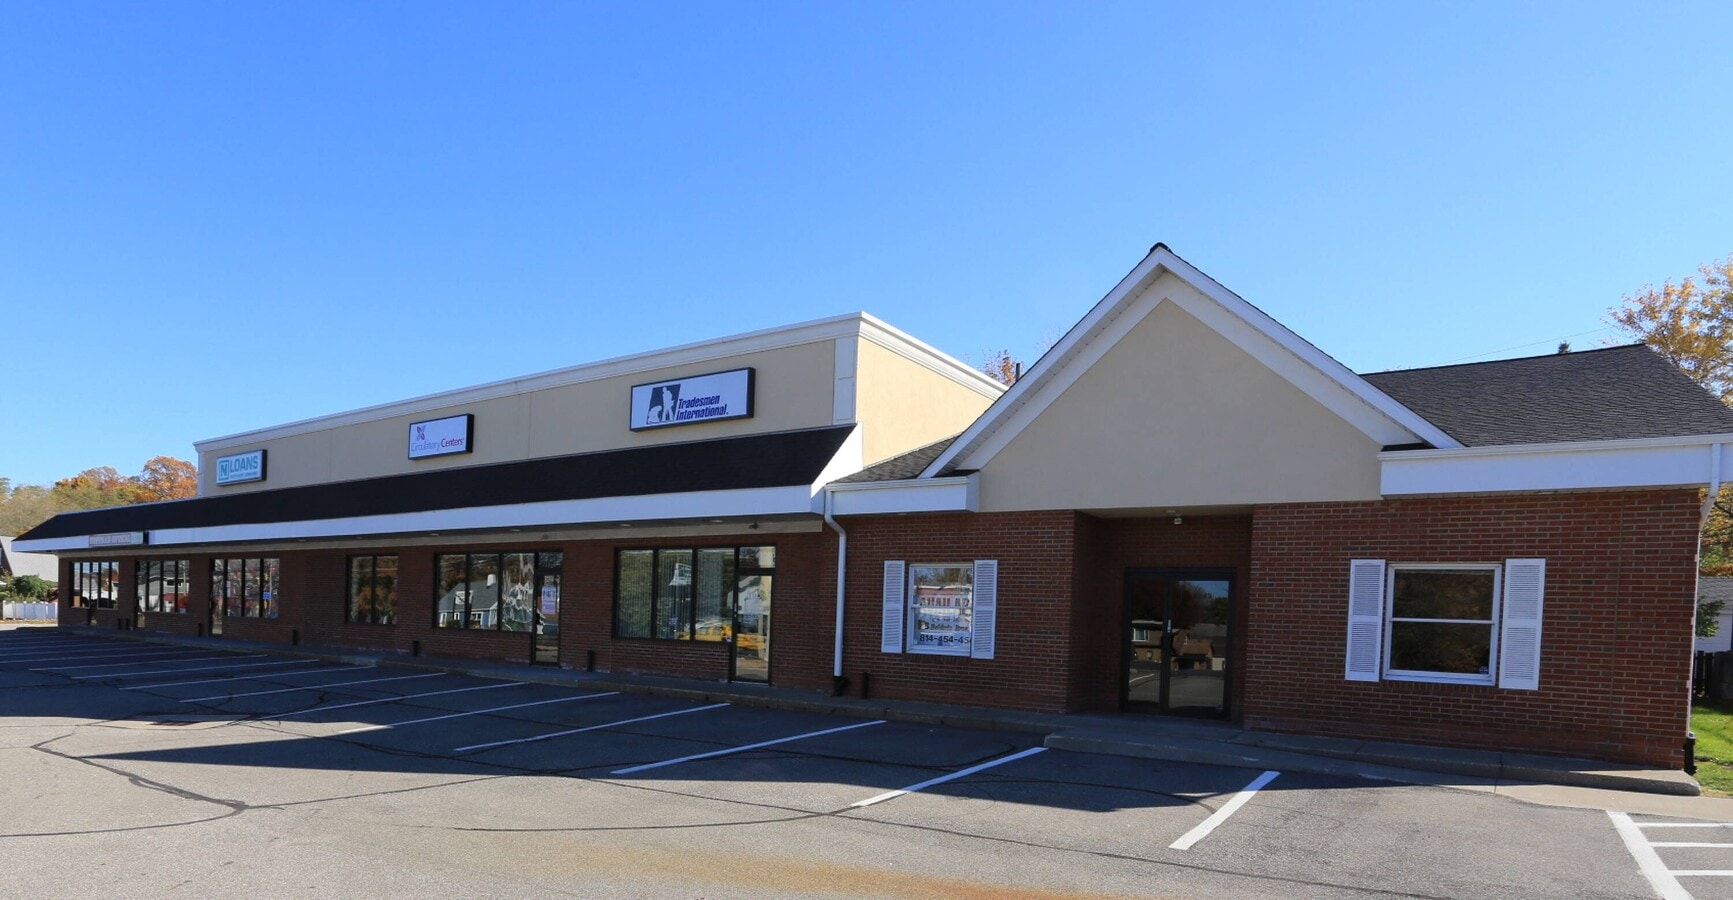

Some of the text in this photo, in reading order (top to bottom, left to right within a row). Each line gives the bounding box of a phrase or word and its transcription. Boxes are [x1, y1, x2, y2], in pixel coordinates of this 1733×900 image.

[678, 395, 720, 409] Tradesmen
[441, 437, 463, 448] Centers
[230, 455, 259, 473] LOANS
[919, 633, 971, 644] 814-454-45
